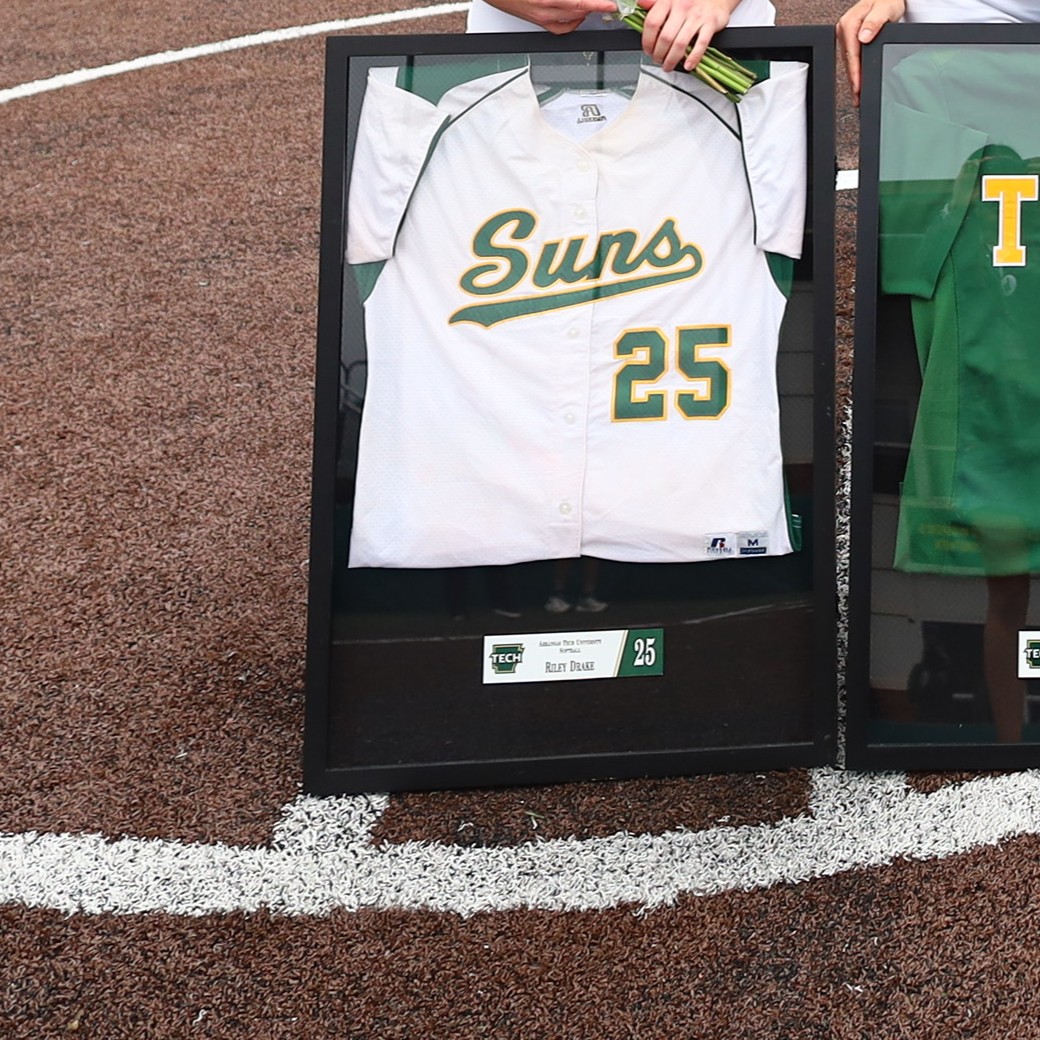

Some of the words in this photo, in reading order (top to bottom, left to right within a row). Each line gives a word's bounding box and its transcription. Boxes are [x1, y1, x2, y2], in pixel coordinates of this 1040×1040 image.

[455, 206, 704, 300] Suns
[611, 323, 732, 423] 25
[491, 653, 522, 664] TECH
[545, 661, 567, 674] RILEY
[569, 660, 595, 673] DRAKE
[633, 637, 656, 667] 25
